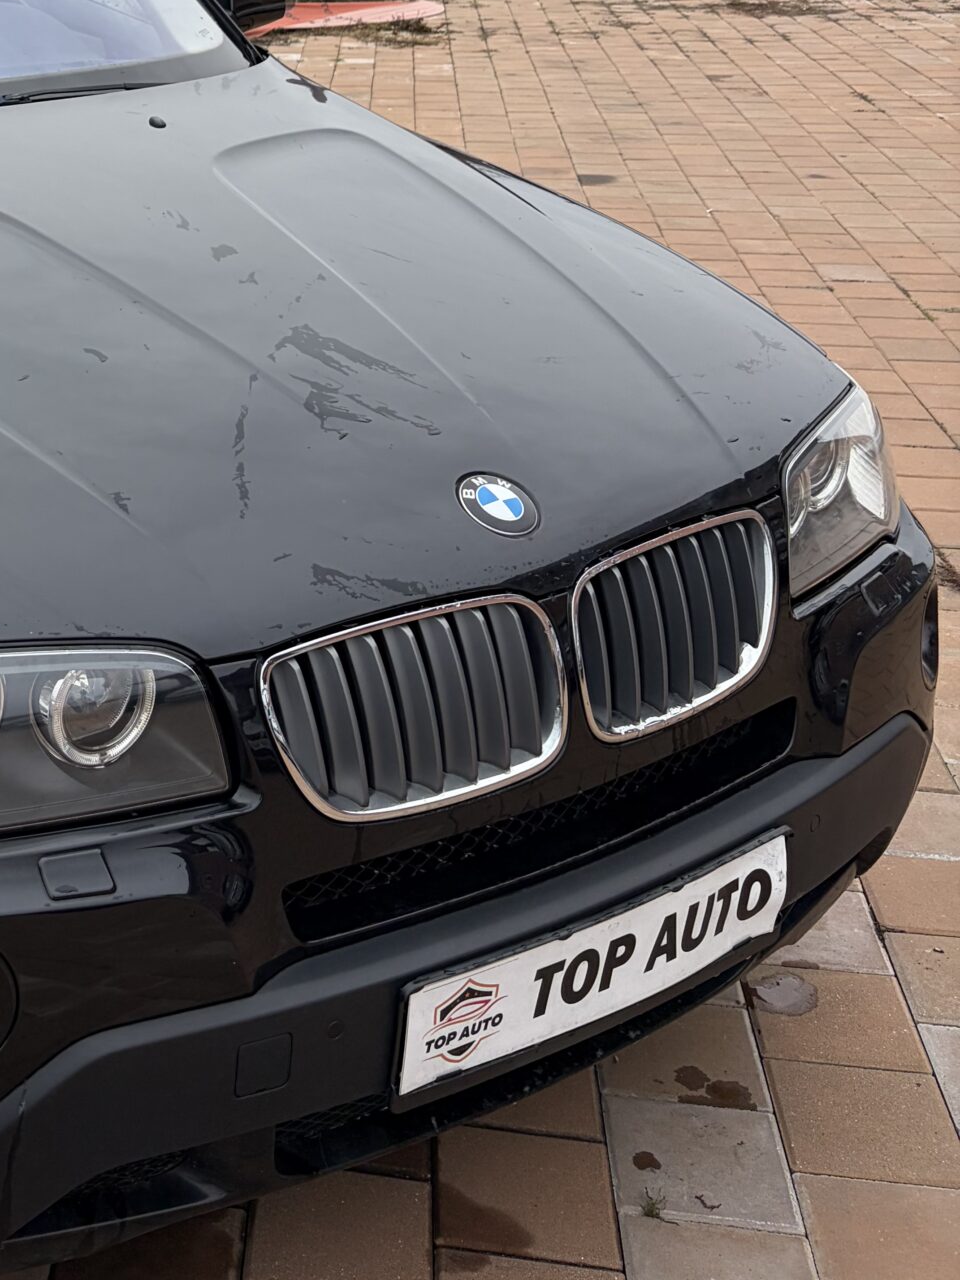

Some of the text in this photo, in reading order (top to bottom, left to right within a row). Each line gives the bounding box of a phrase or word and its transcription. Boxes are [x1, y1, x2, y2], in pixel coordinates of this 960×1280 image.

[462, 476, 512, 499] BMW
[533, 868, 773, 1019] TOP AUTO
[425, 1013, 503, 1053] TOP AUTO
